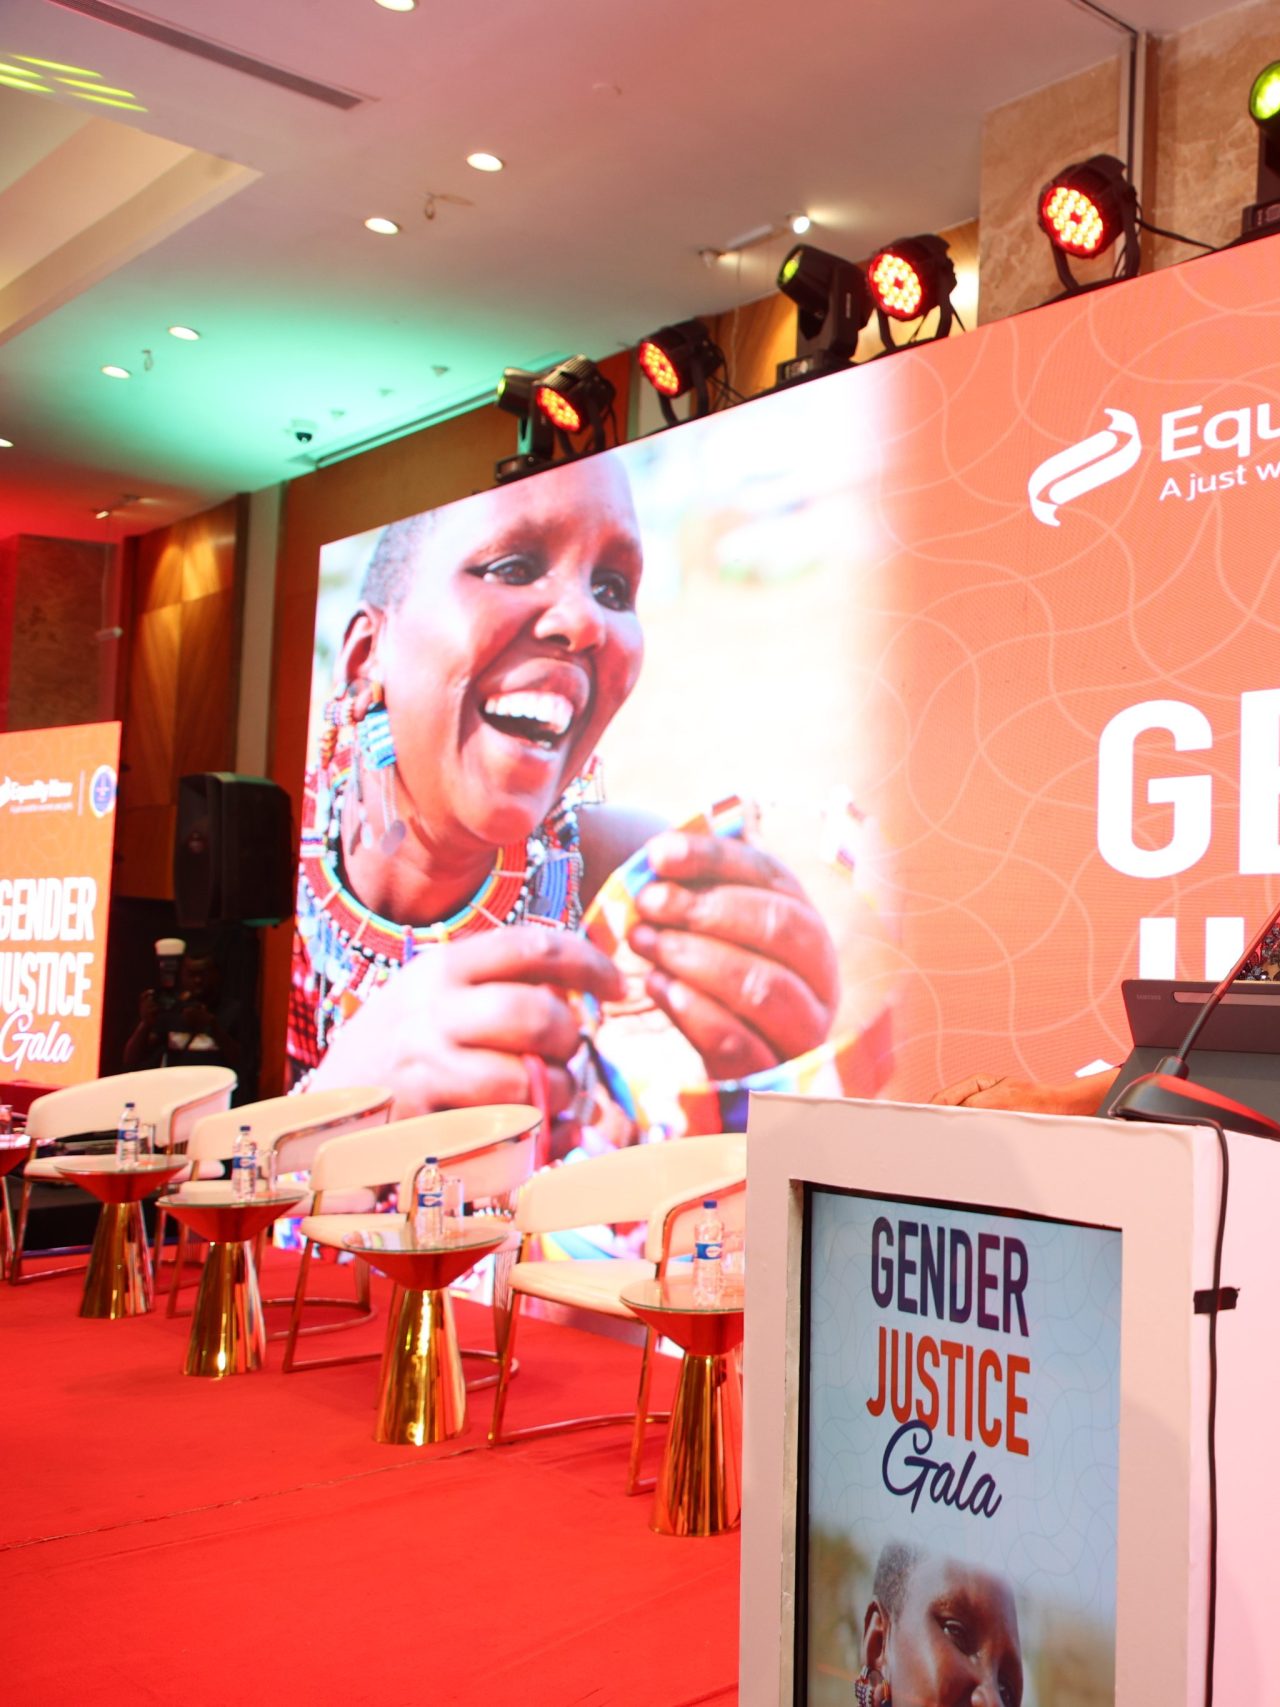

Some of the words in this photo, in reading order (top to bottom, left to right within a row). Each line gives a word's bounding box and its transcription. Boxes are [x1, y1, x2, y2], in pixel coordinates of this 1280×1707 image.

[1159, 477, 1182, 502] A
[1186, 462, 1248, 502] just
[0, 1008, 75, 1072] Gala
[871, 1216, 1030, 1338] GENDER
[866, 1326, 1031, 1457] JUSTICE
[882, 1419, 1003, 1519] Gala
